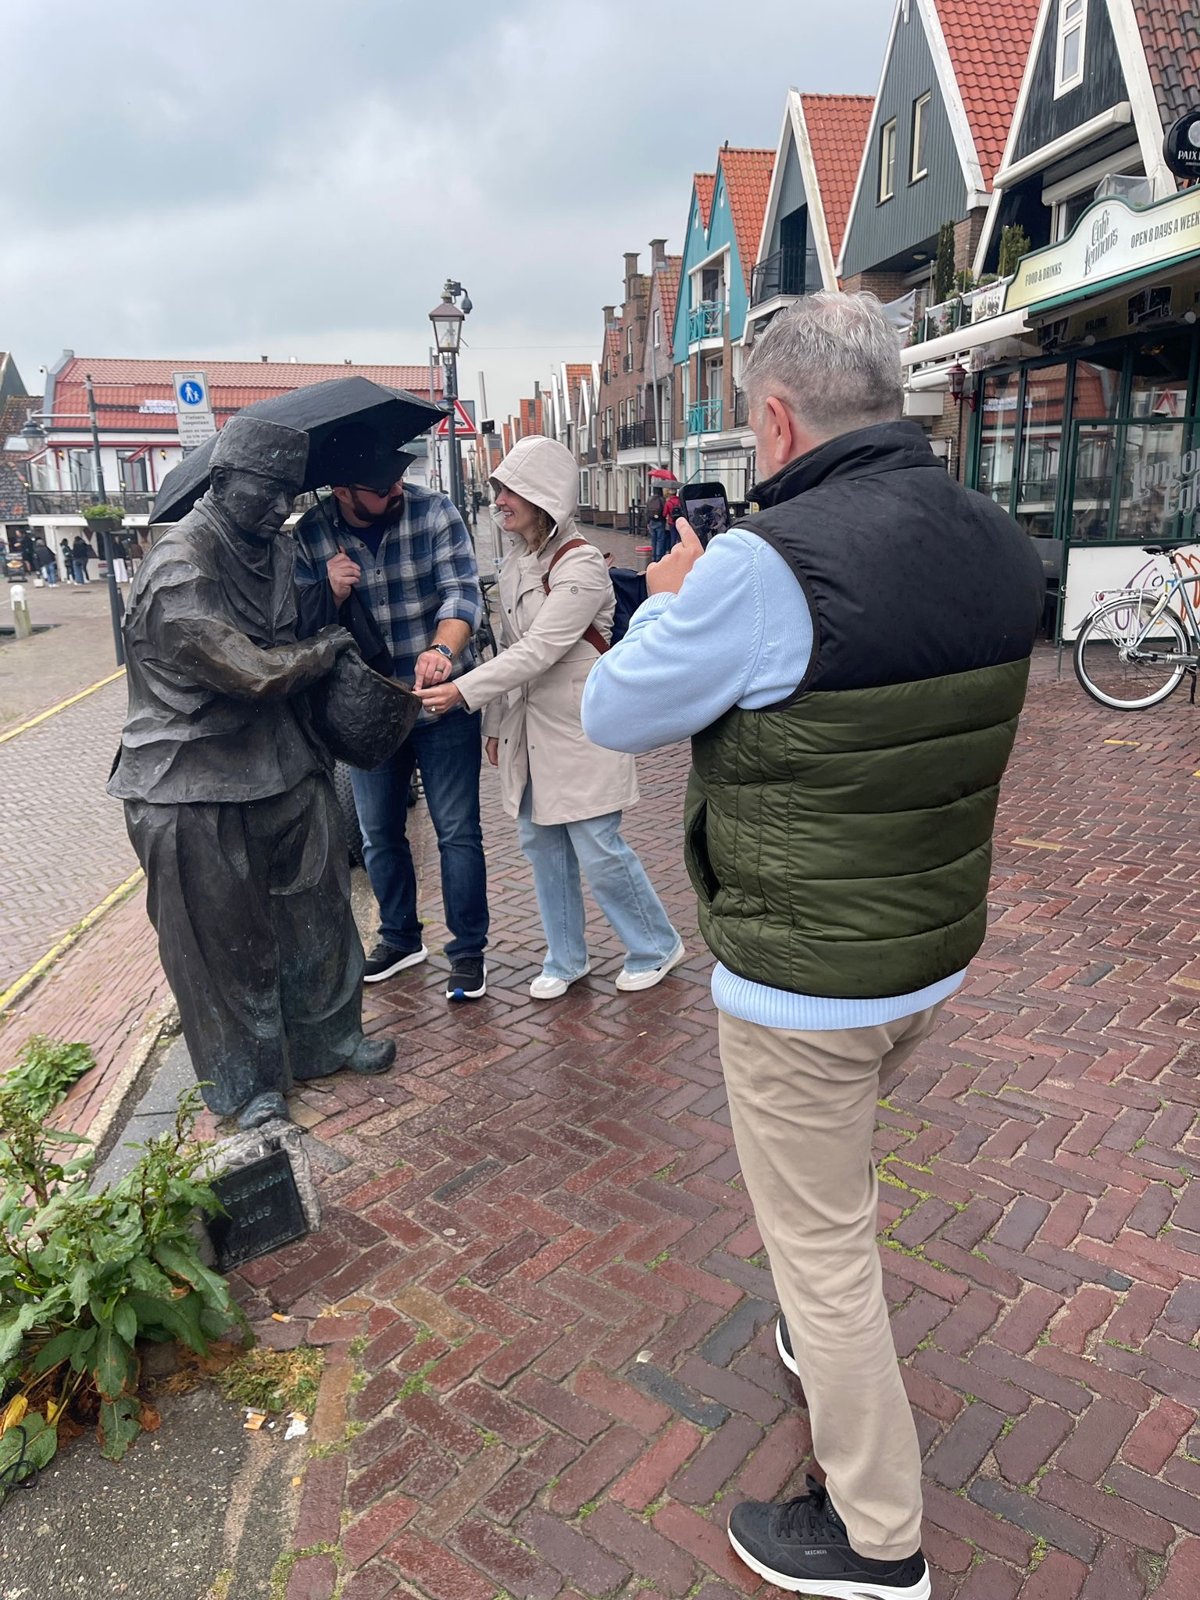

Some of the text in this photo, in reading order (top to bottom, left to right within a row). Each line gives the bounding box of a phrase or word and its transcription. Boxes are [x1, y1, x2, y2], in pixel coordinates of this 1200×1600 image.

[1177, 150, 1198, 161] PAIX
[1130, 231, 1148, 249] OPEN
[1148, 227, 1154, 243] 8
[1154, 221, 1173, 241] DAYS
[1173, 218, 1179, 234] A
[1025, 262, 1062, 287] FOOD & DRINKS
